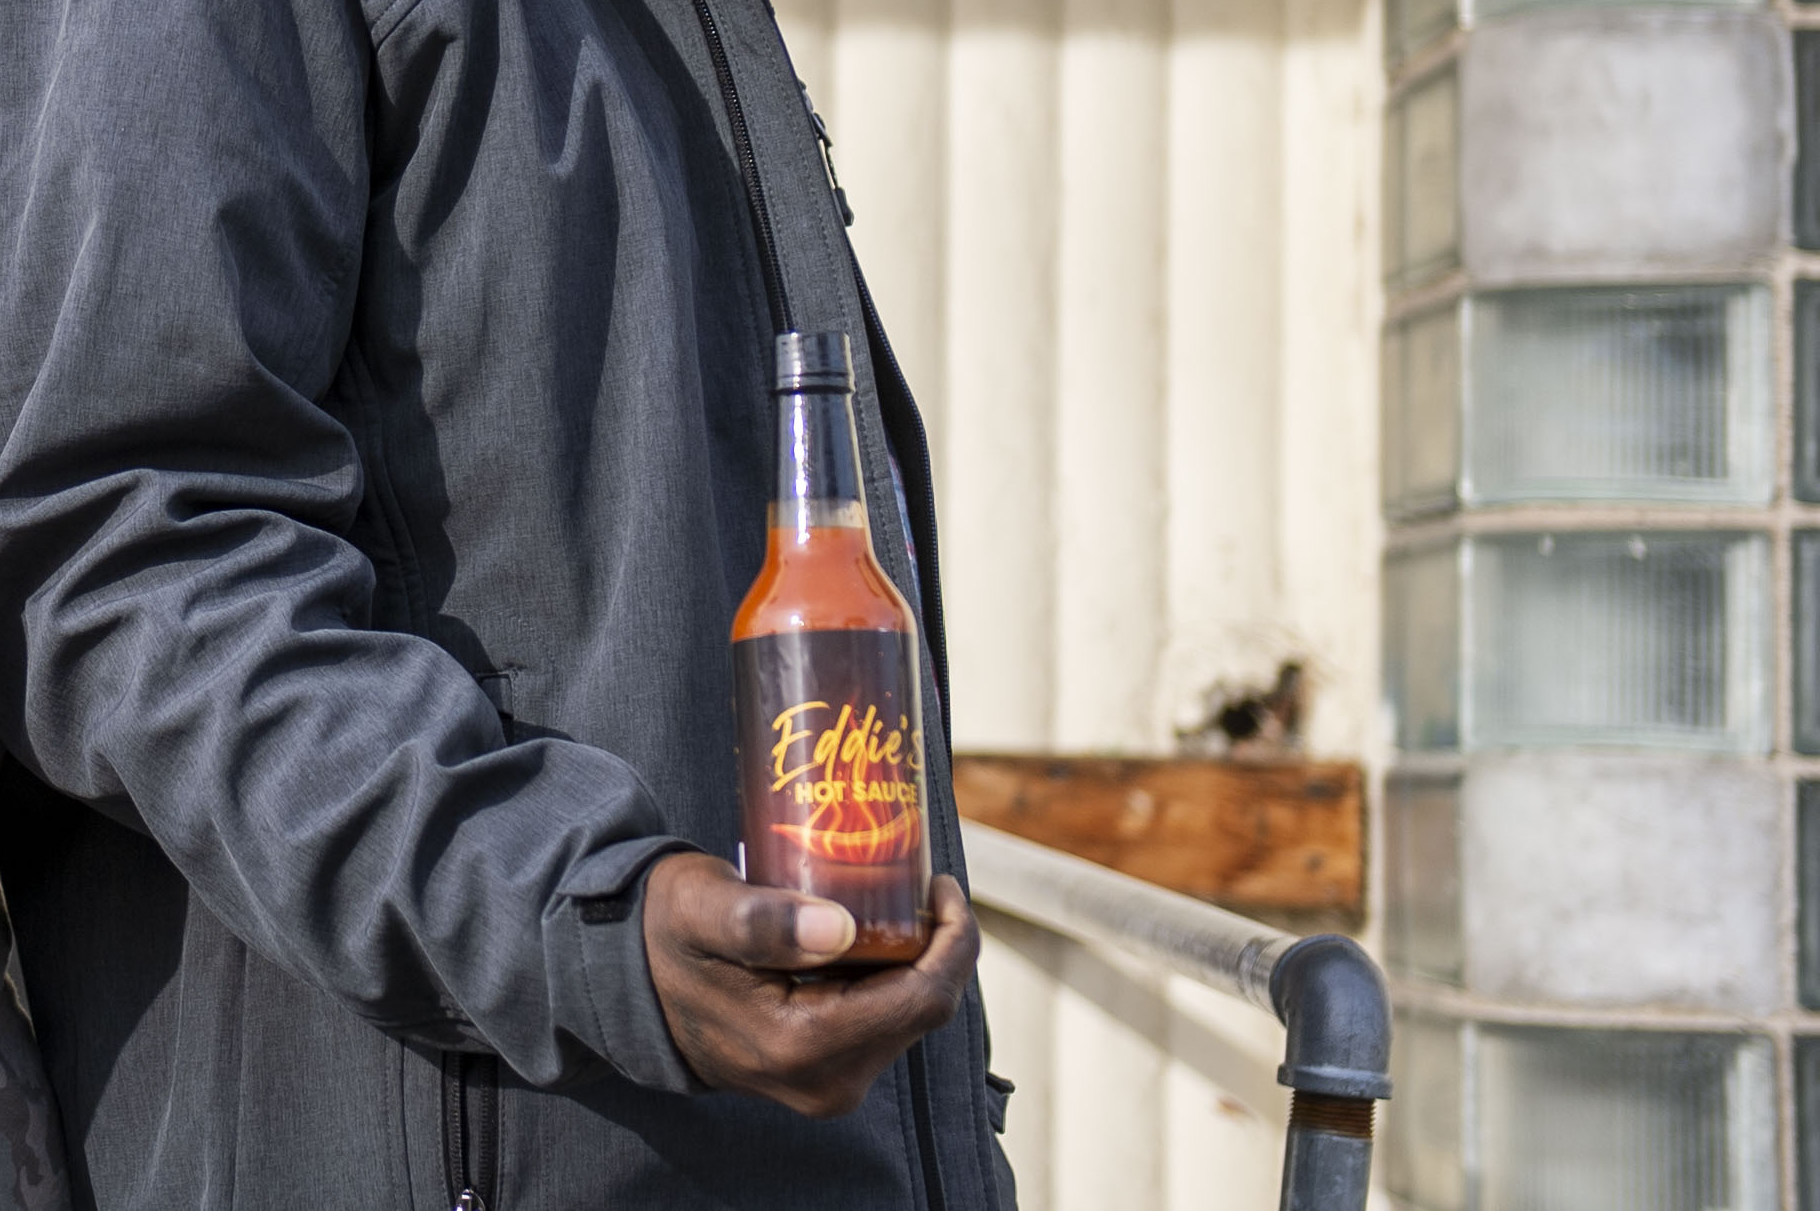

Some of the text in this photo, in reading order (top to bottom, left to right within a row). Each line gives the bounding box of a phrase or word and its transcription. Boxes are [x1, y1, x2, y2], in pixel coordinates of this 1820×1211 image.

[771, 700, 923, 793] Eddie's
[794, 780, 918, 805] HOT SAUCE
